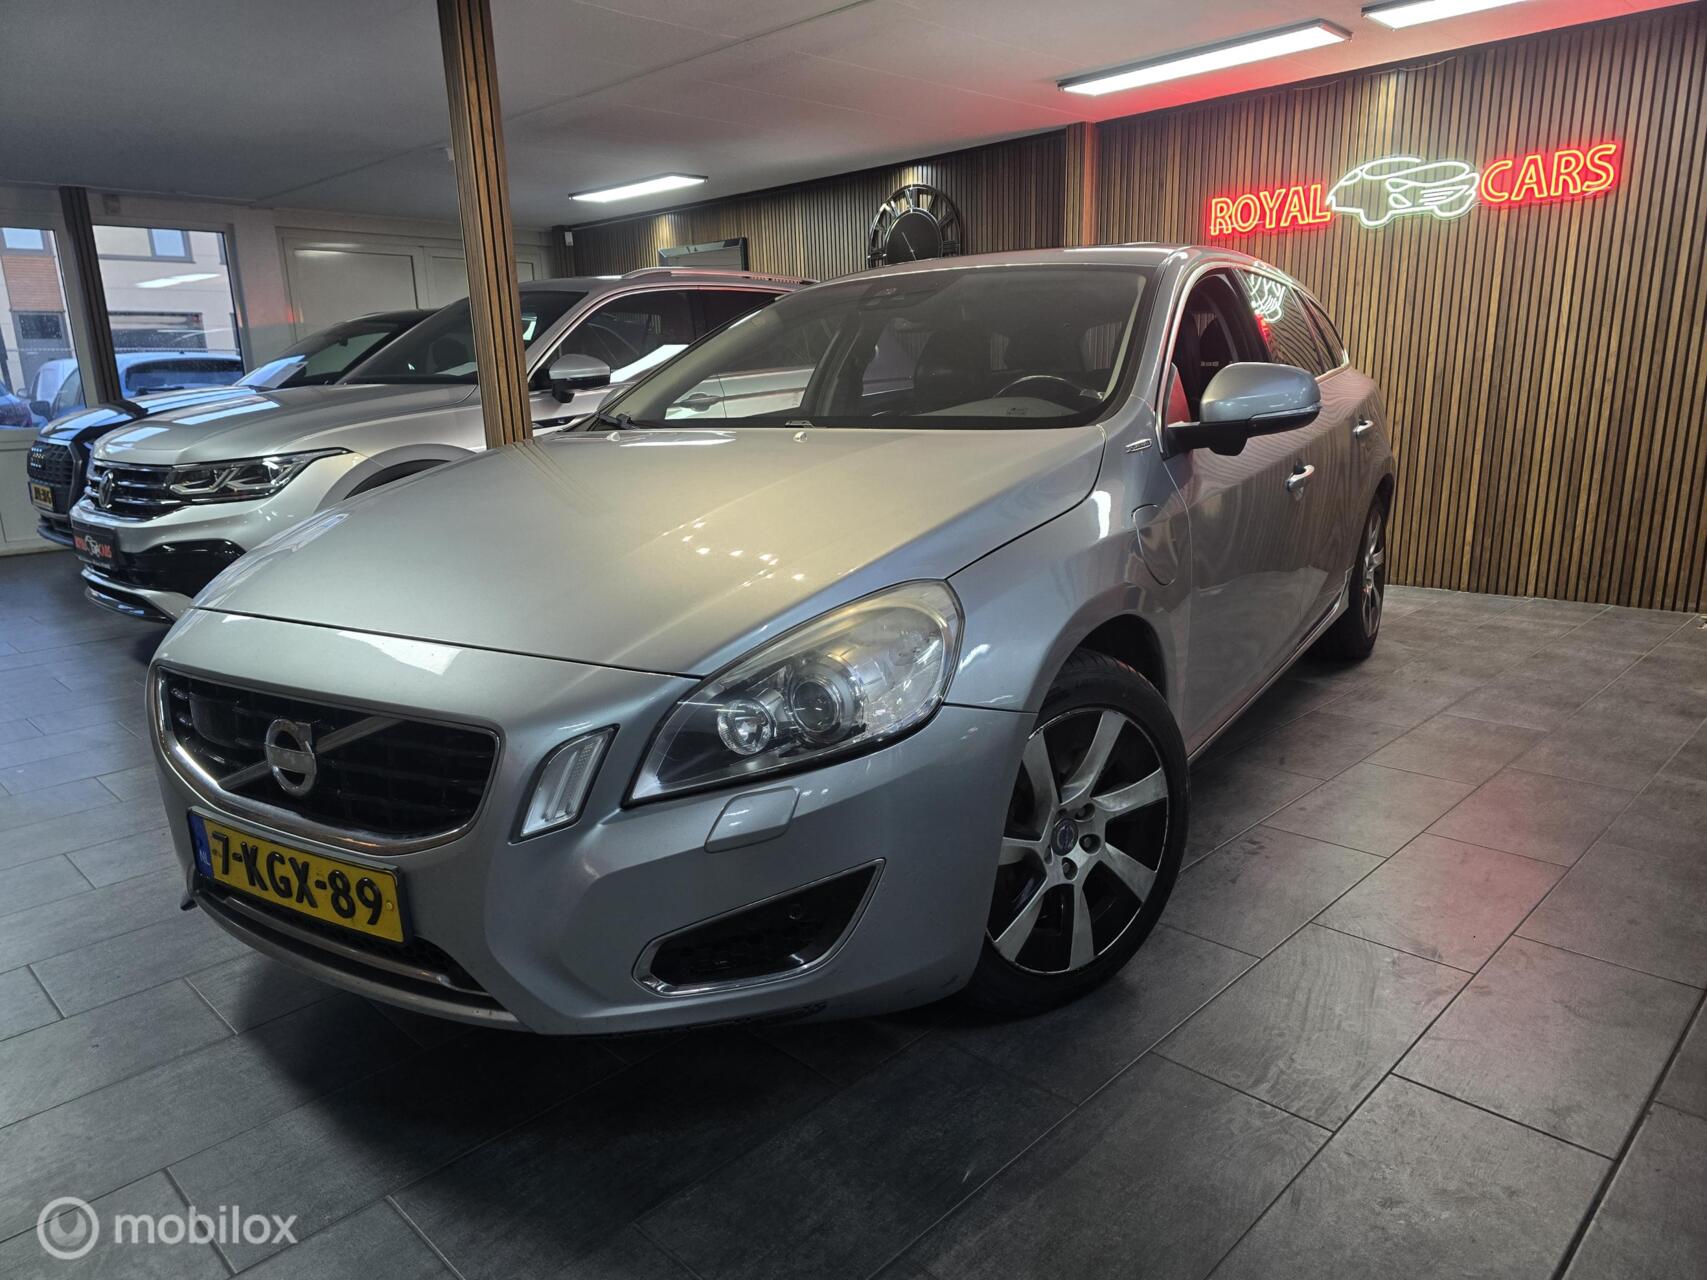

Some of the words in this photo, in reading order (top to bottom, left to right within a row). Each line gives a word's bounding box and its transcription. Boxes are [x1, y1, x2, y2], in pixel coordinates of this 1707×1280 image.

[1210, 184, 1331, 235] ROYAL
[1481, 144, 1617, 202] CARS
[211, 831, 383, 926] 7-KGX-89
